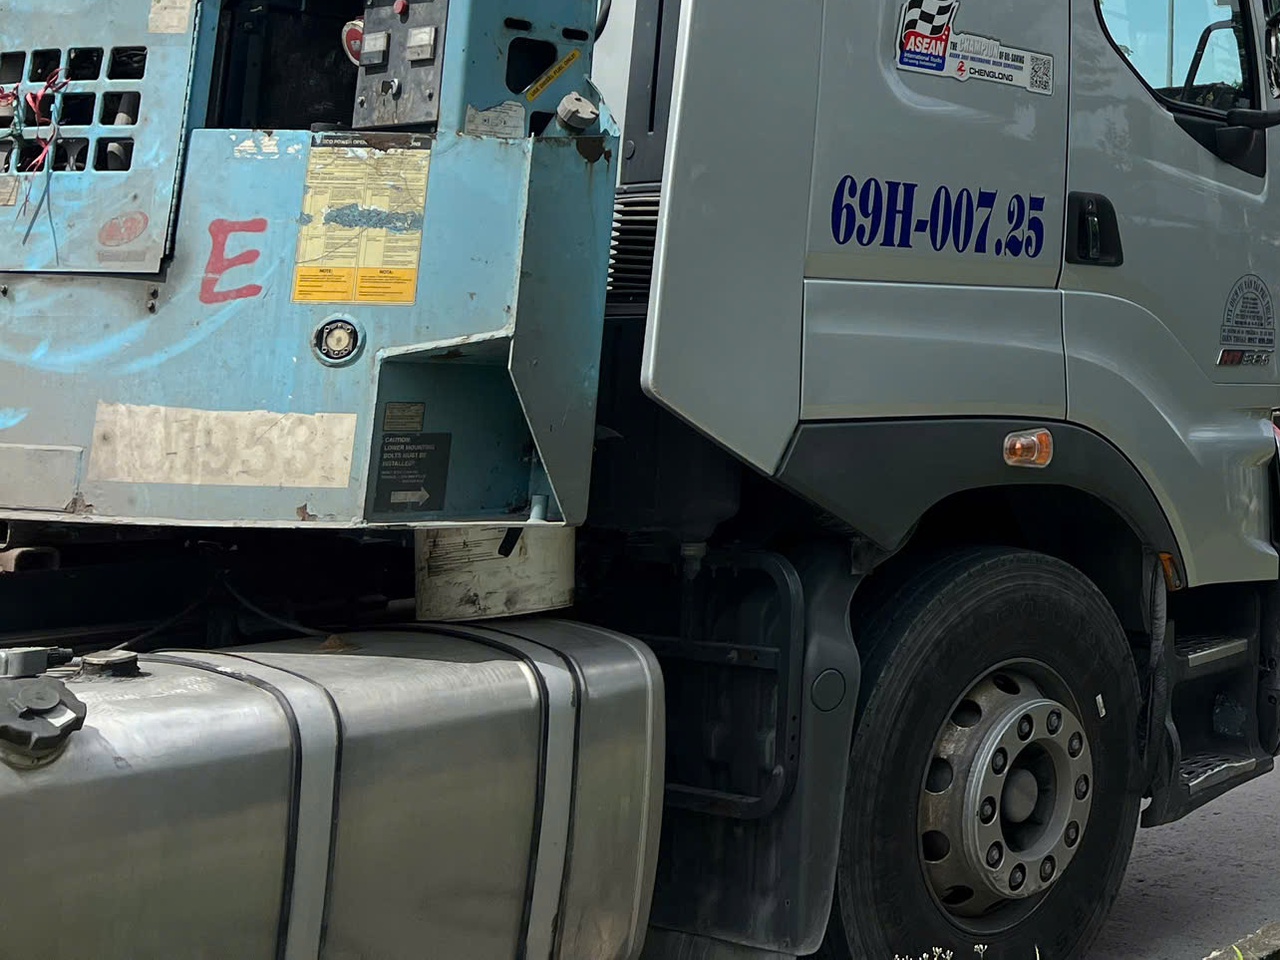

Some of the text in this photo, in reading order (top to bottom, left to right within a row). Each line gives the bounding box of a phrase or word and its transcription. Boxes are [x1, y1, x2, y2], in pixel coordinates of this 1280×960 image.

[906, 35, 945, 57] ASEAN
[958, 33, 1000, 59] CHAMPION
[969, 67, 1014, 82] CHENGLONG
[831, 174, 1045, 258] 69H-007.25
[199, 218, 268, 304] E
